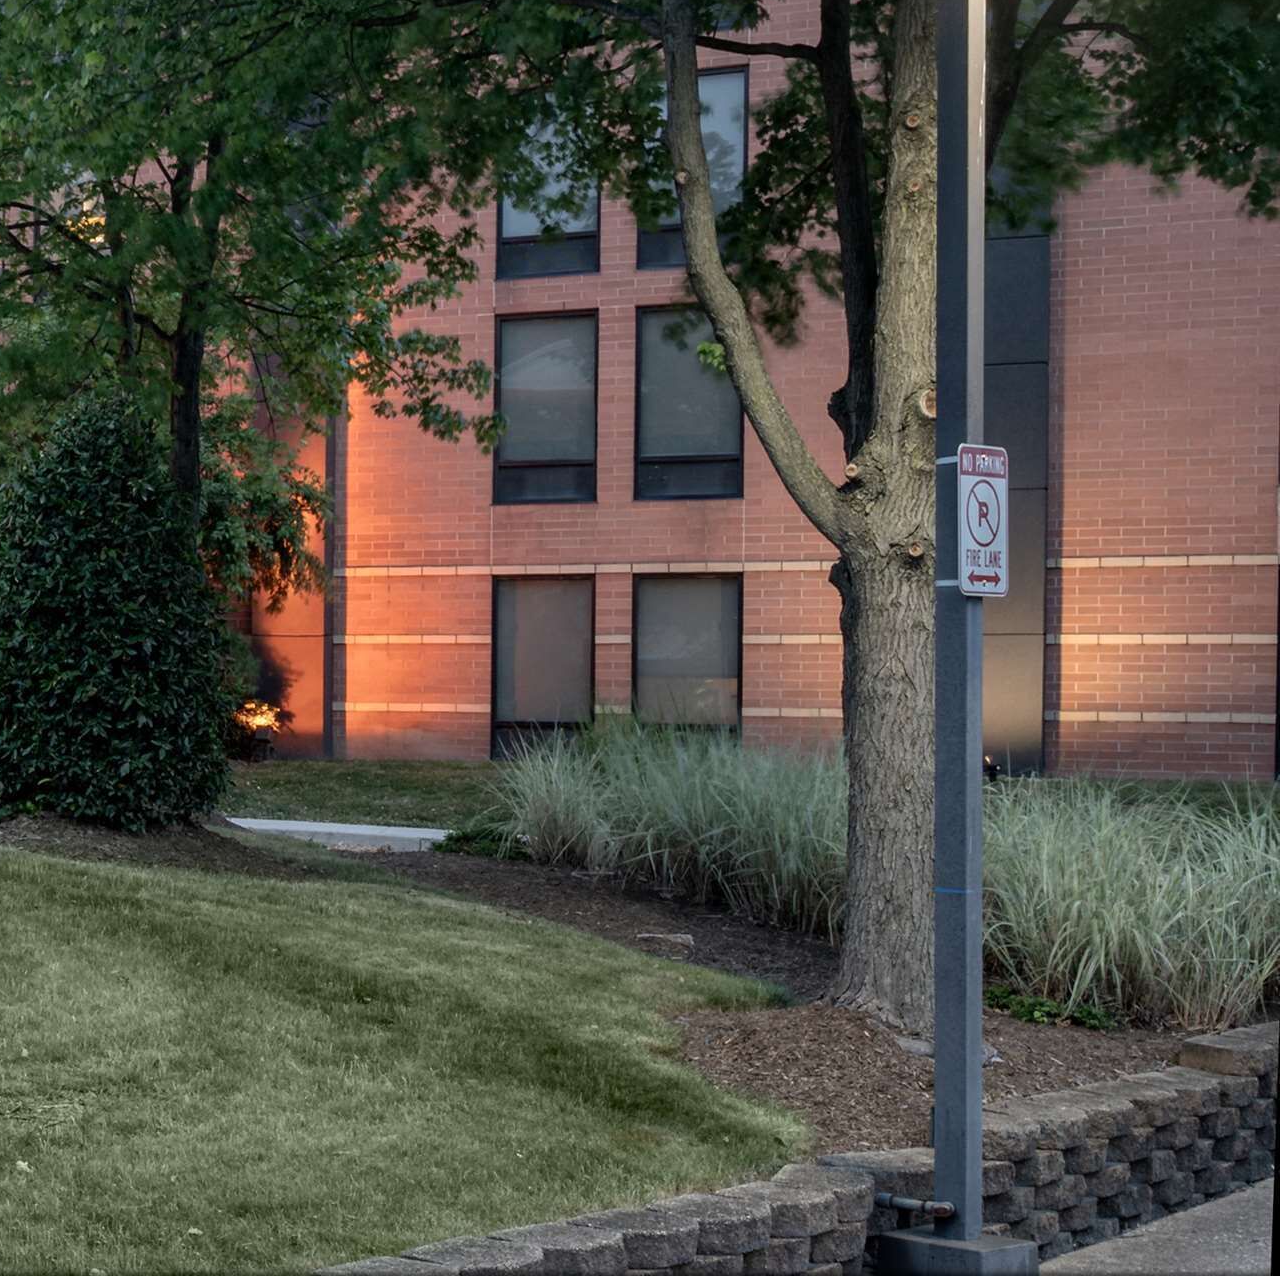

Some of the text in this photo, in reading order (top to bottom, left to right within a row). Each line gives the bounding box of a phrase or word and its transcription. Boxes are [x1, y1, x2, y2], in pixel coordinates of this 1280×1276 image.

[962, 453, 1005, 474] NO PARKING
[966, 549, 1002, 570] FIRE LANE
